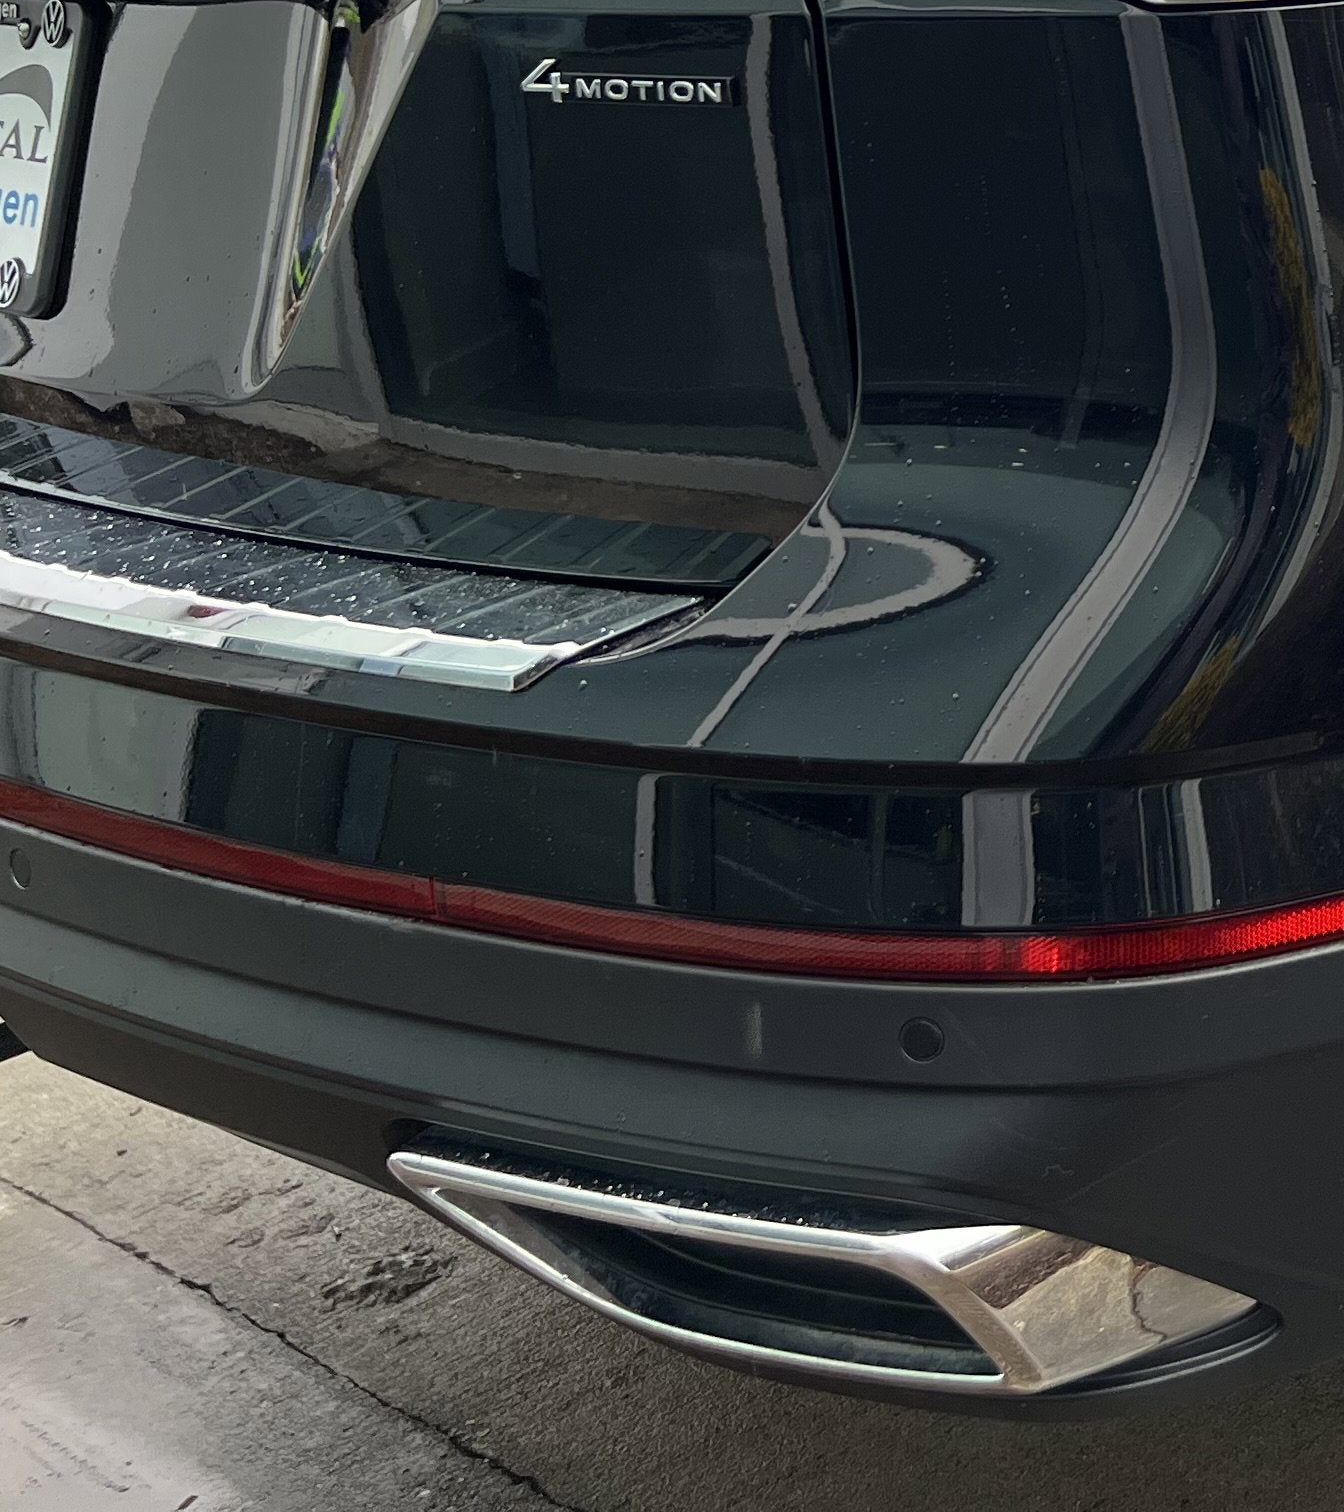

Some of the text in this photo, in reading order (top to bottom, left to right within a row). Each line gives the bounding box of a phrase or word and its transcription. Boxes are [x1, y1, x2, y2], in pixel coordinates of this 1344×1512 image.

[0, 3, 17, 19] en
[521, 58, 721, 103] 4MOTION
[0, 189, 39, 228] en
